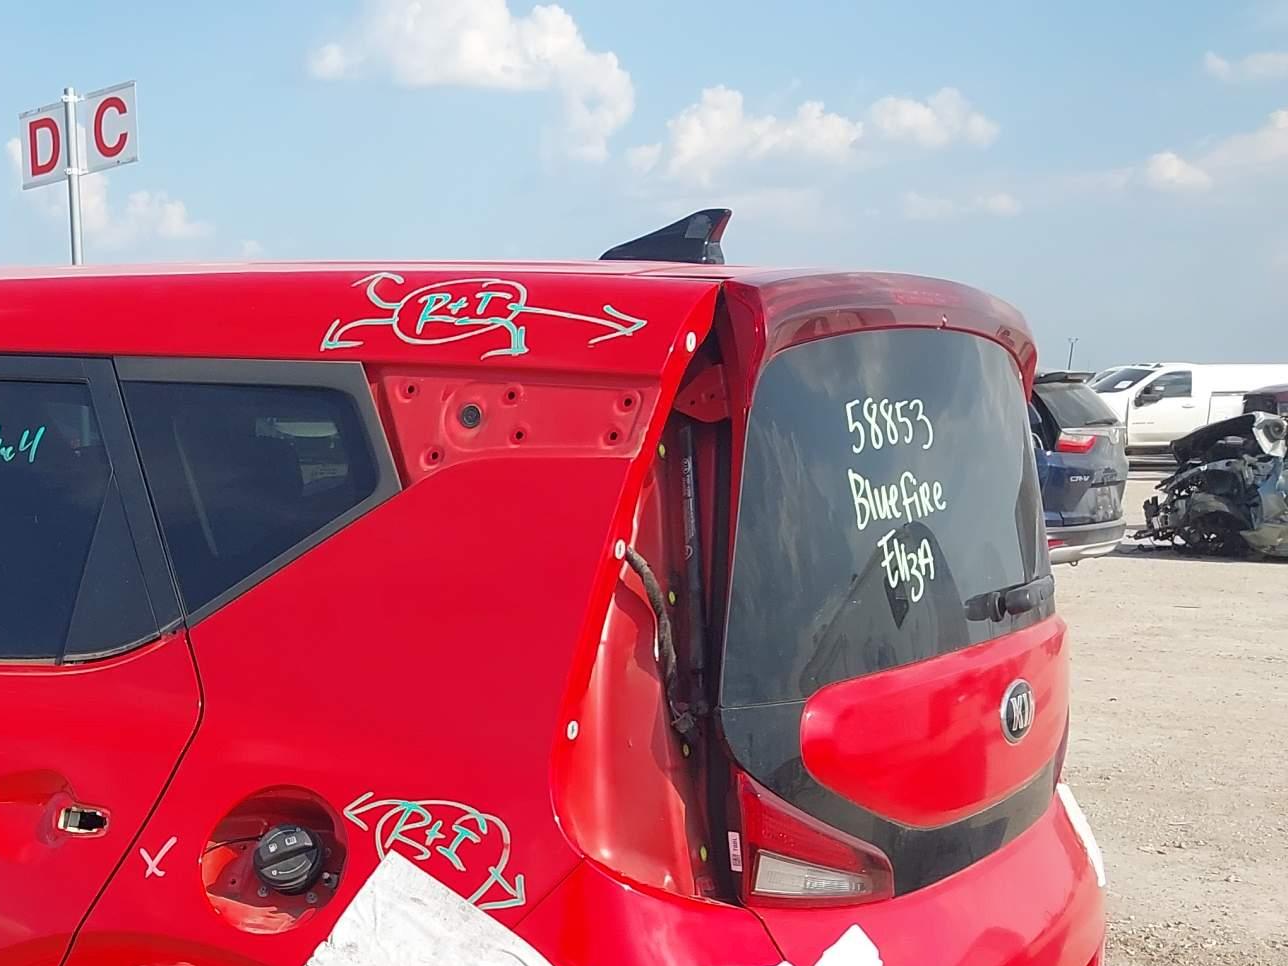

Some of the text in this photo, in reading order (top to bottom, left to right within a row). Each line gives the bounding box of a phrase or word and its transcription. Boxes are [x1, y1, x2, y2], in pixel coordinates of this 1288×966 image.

[28, 117, 61, 178] D
[93, 96, 129, 158] C
[845, 397, 935, 454] 58853
